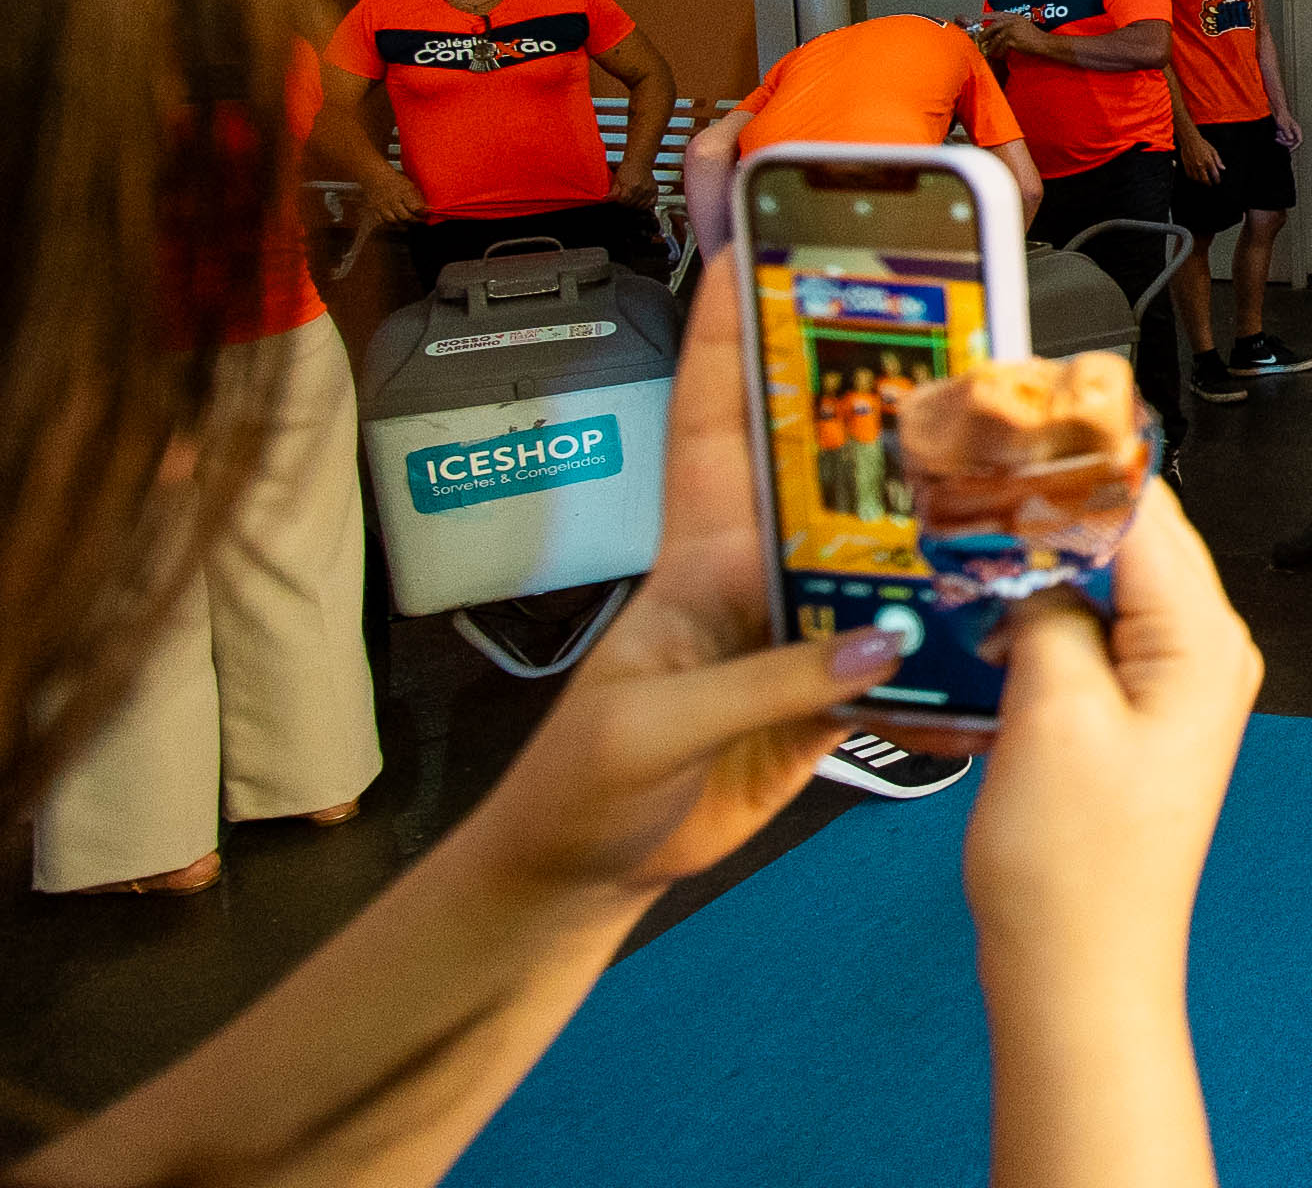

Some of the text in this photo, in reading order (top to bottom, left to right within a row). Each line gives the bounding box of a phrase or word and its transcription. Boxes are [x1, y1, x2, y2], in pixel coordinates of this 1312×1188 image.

[436, 340, 501, 354] CARRINHO
[437, 336, 491, 348] NOSSO
[426, 429, 604, 485] ICESHOP
[432, 454, 606, 497] Sorvetes & Congelados
